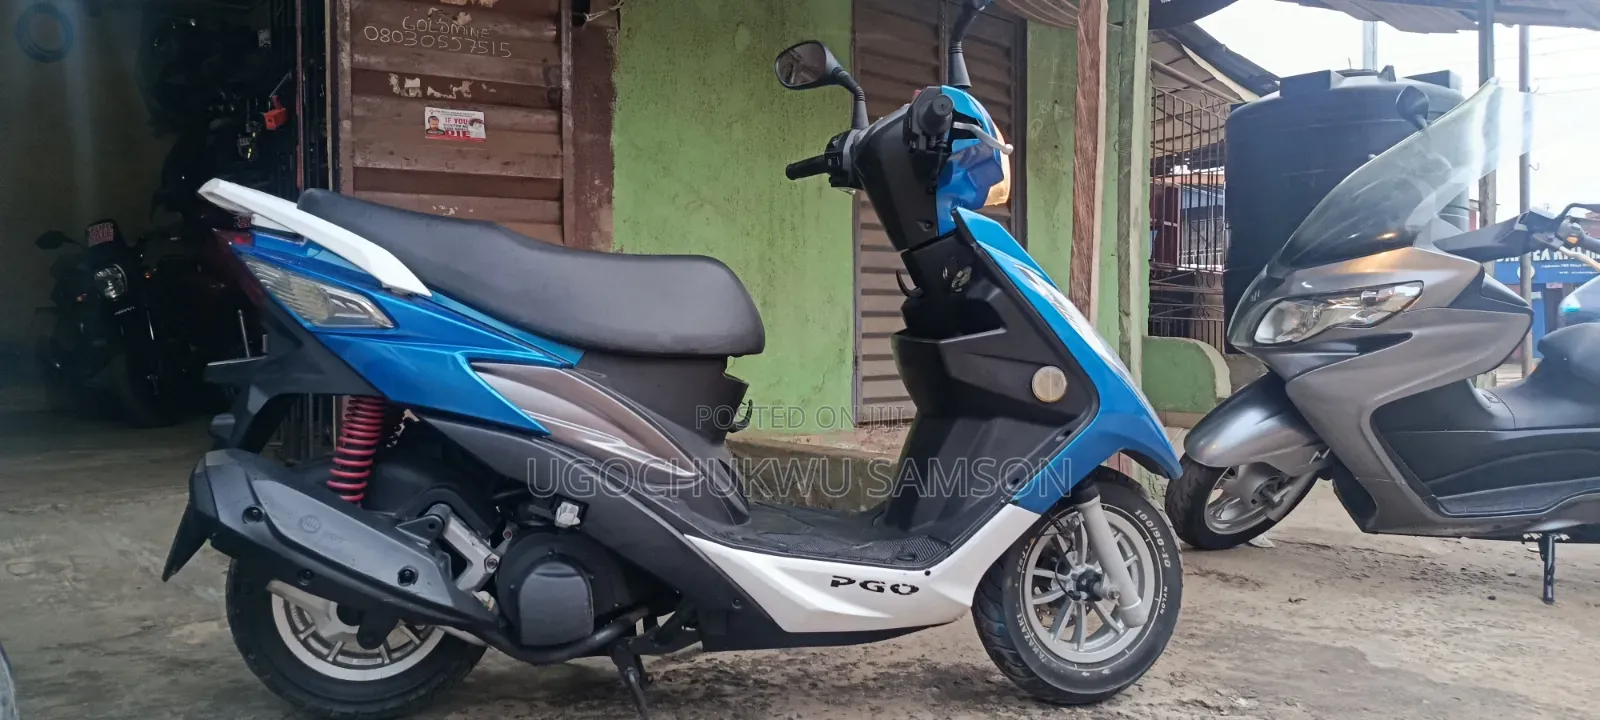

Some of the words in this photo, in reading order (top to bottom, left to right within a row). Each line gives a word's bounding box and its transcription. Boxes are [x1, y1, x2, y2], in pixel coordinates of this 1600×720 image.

[364, 25, 512, 58] 08030557515
[402, 16, 492, 38] GOLDMINE
[1134, 509, 1171, 568] 100/90-10
[830, 575, 920, 596] PGO
[1159, 585, 1168, 614] NYLON
